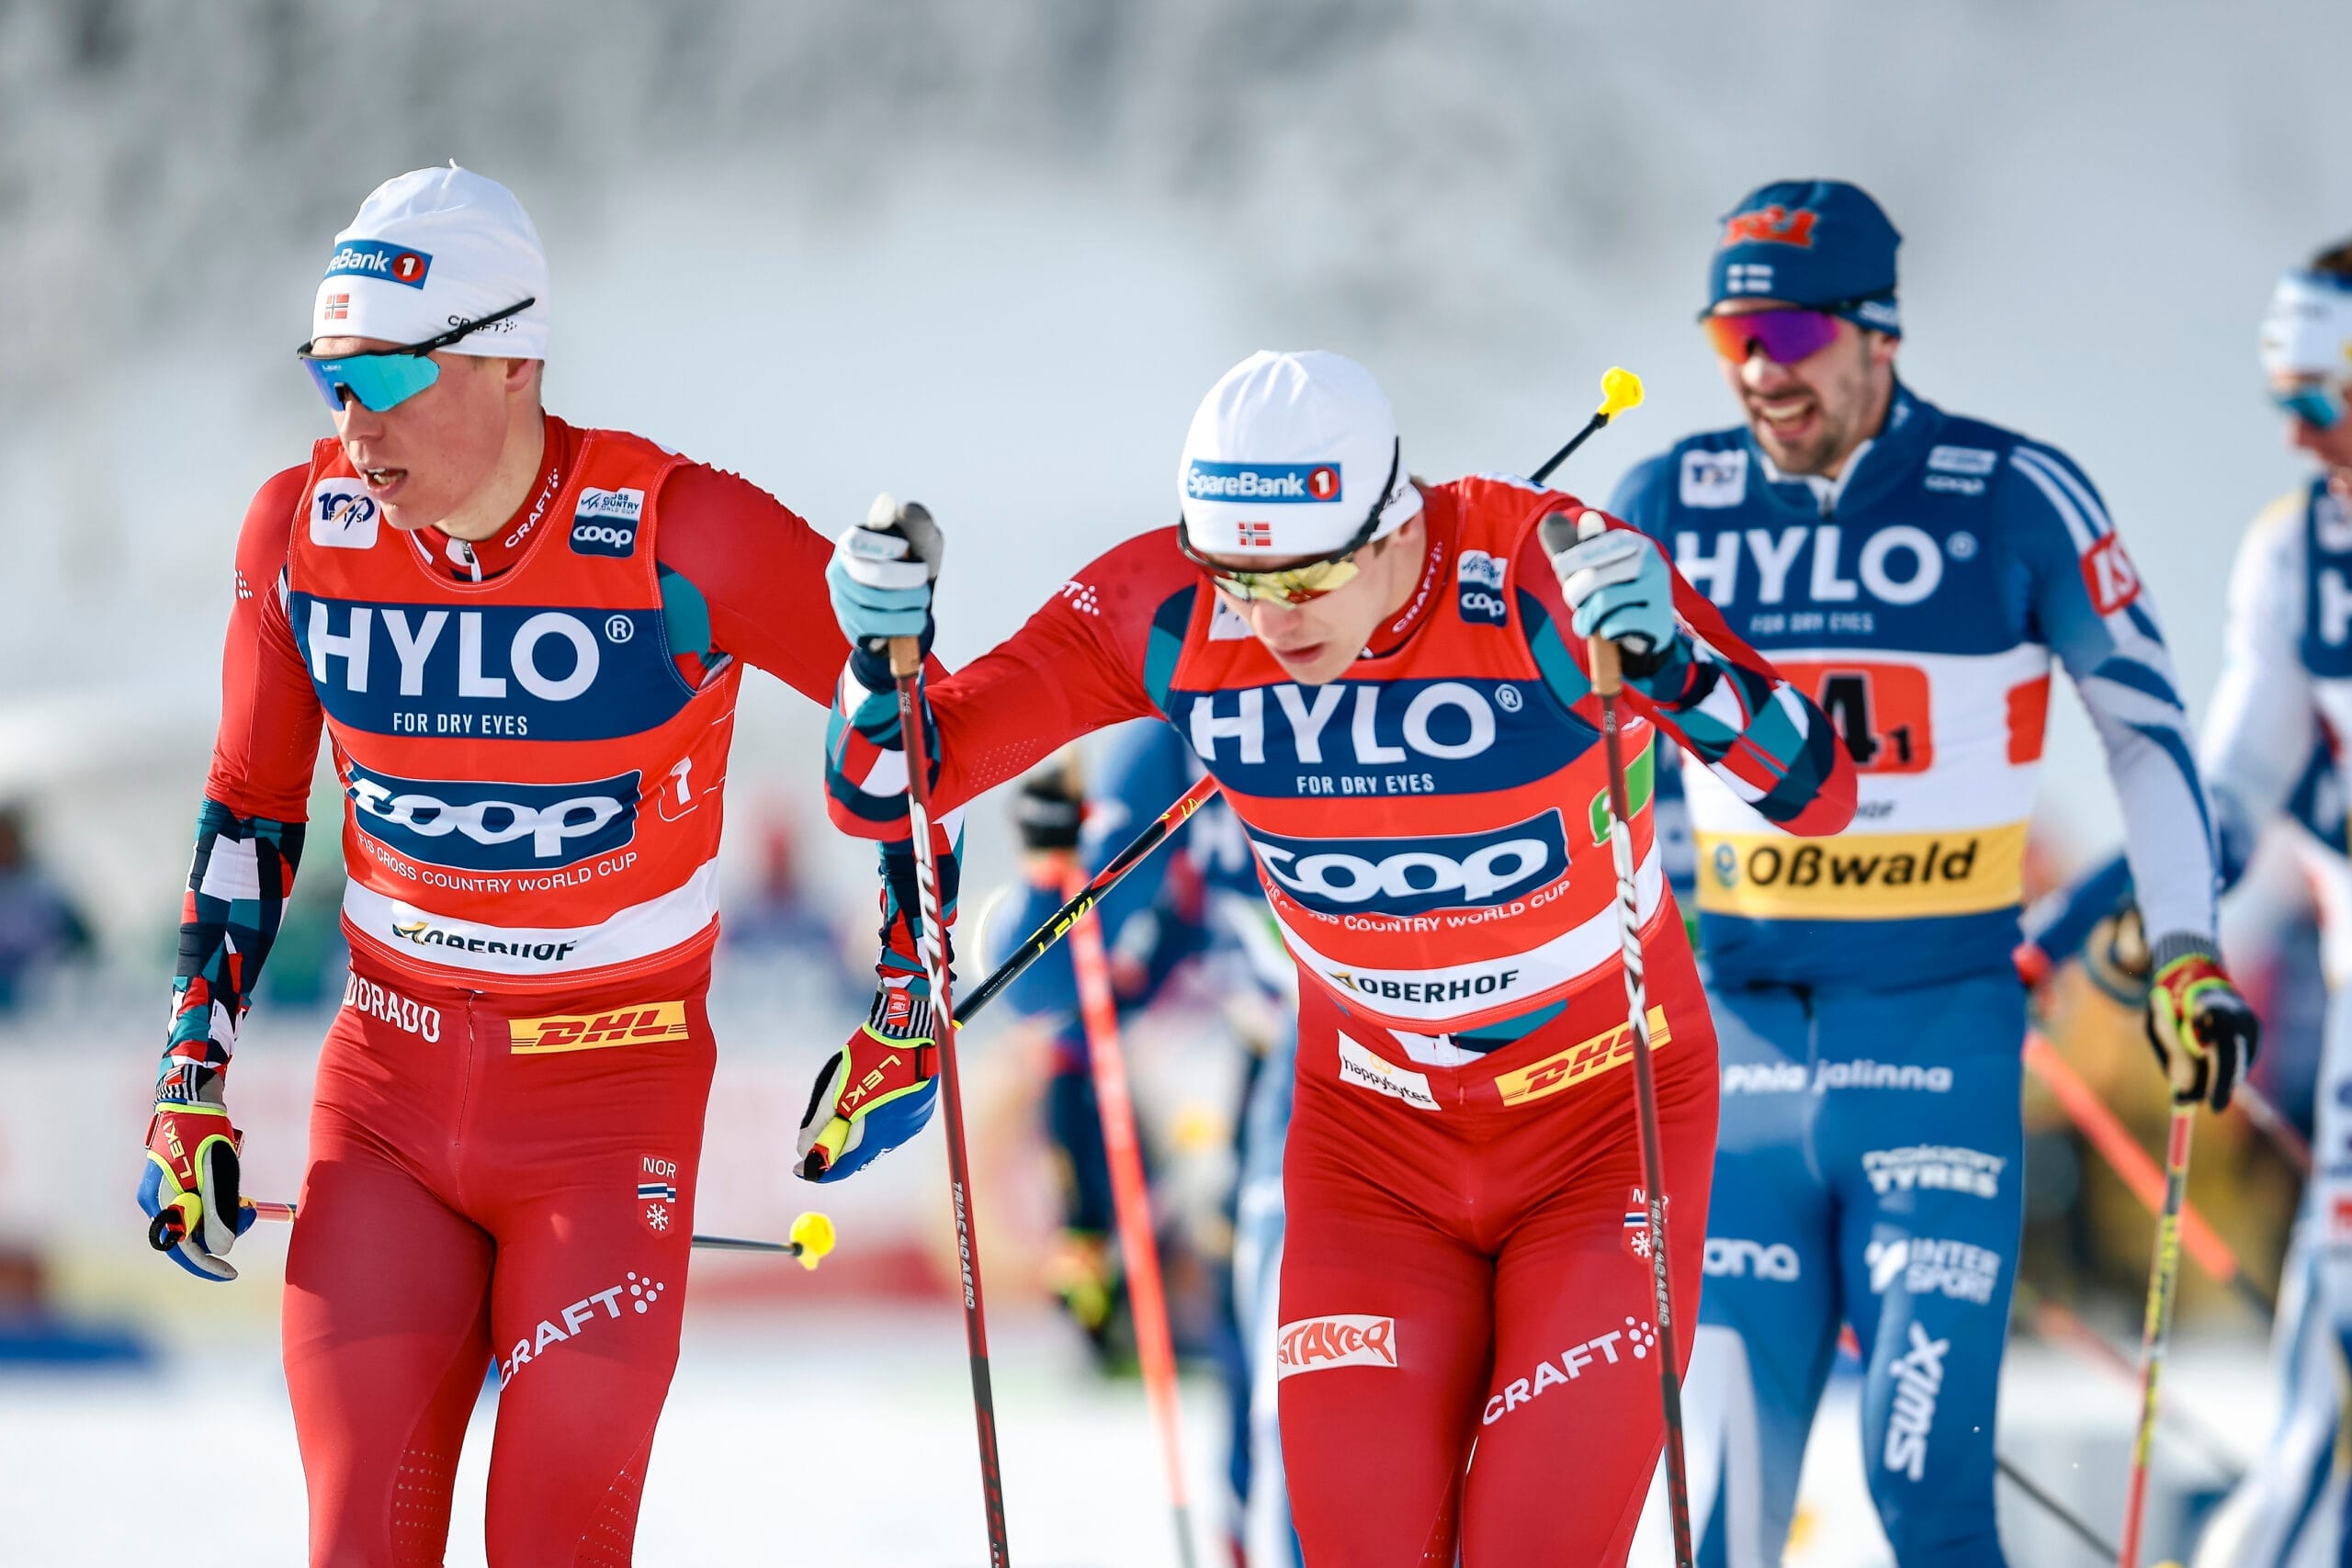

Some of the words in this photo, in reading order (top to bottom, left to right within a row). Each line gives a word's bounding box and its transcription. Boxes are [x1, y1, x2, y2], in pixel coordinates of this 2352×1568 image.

[1188, 468, 1305, 497] SpareBank
[505, 489, 552, 548] CRAFT
[572, 525, 632, 548] coop
[393, 712, 428, 733] FOR
[437, 713, 473, 734] DRY
[481, 714, 528, 736] EYES
[1296, 776, 1336, 795] FOR
[1340, 775, 1377, 795] DRY
[1386, 773, 1435, 793] EYES
[358, 832, 375, 854] FIS
[377, 846, 417, 881] CROSS
[423, 871, 513, 894] COUNTRY
[517, 866, 592, 891] WORLD
[598, 852, 638, 877] CUP
[1252, 838, 1549, 900] coop
[1747, 840, 1979, 887] Oßwald
[1449, 901, 1525, 930] WORLD
[1531, 880, 1570, 908] CUP
[1359, 969, 1520, 1003] OBERHOF
[536, 1010, 669, 1047] DHL
[842, 1054, 901, 1112] LEKI
[1343, 1054, 1432, 1104] happybytes
[163, 1120, 193, 1179] LEKI
[643, 1156, 676, 1179] NOR
[499, 1284, 624, 1392] CRAFT
[1278, 1317, 1394, 1366] STAYER
[1482, 1329, 1623, 1426] CRAFT
